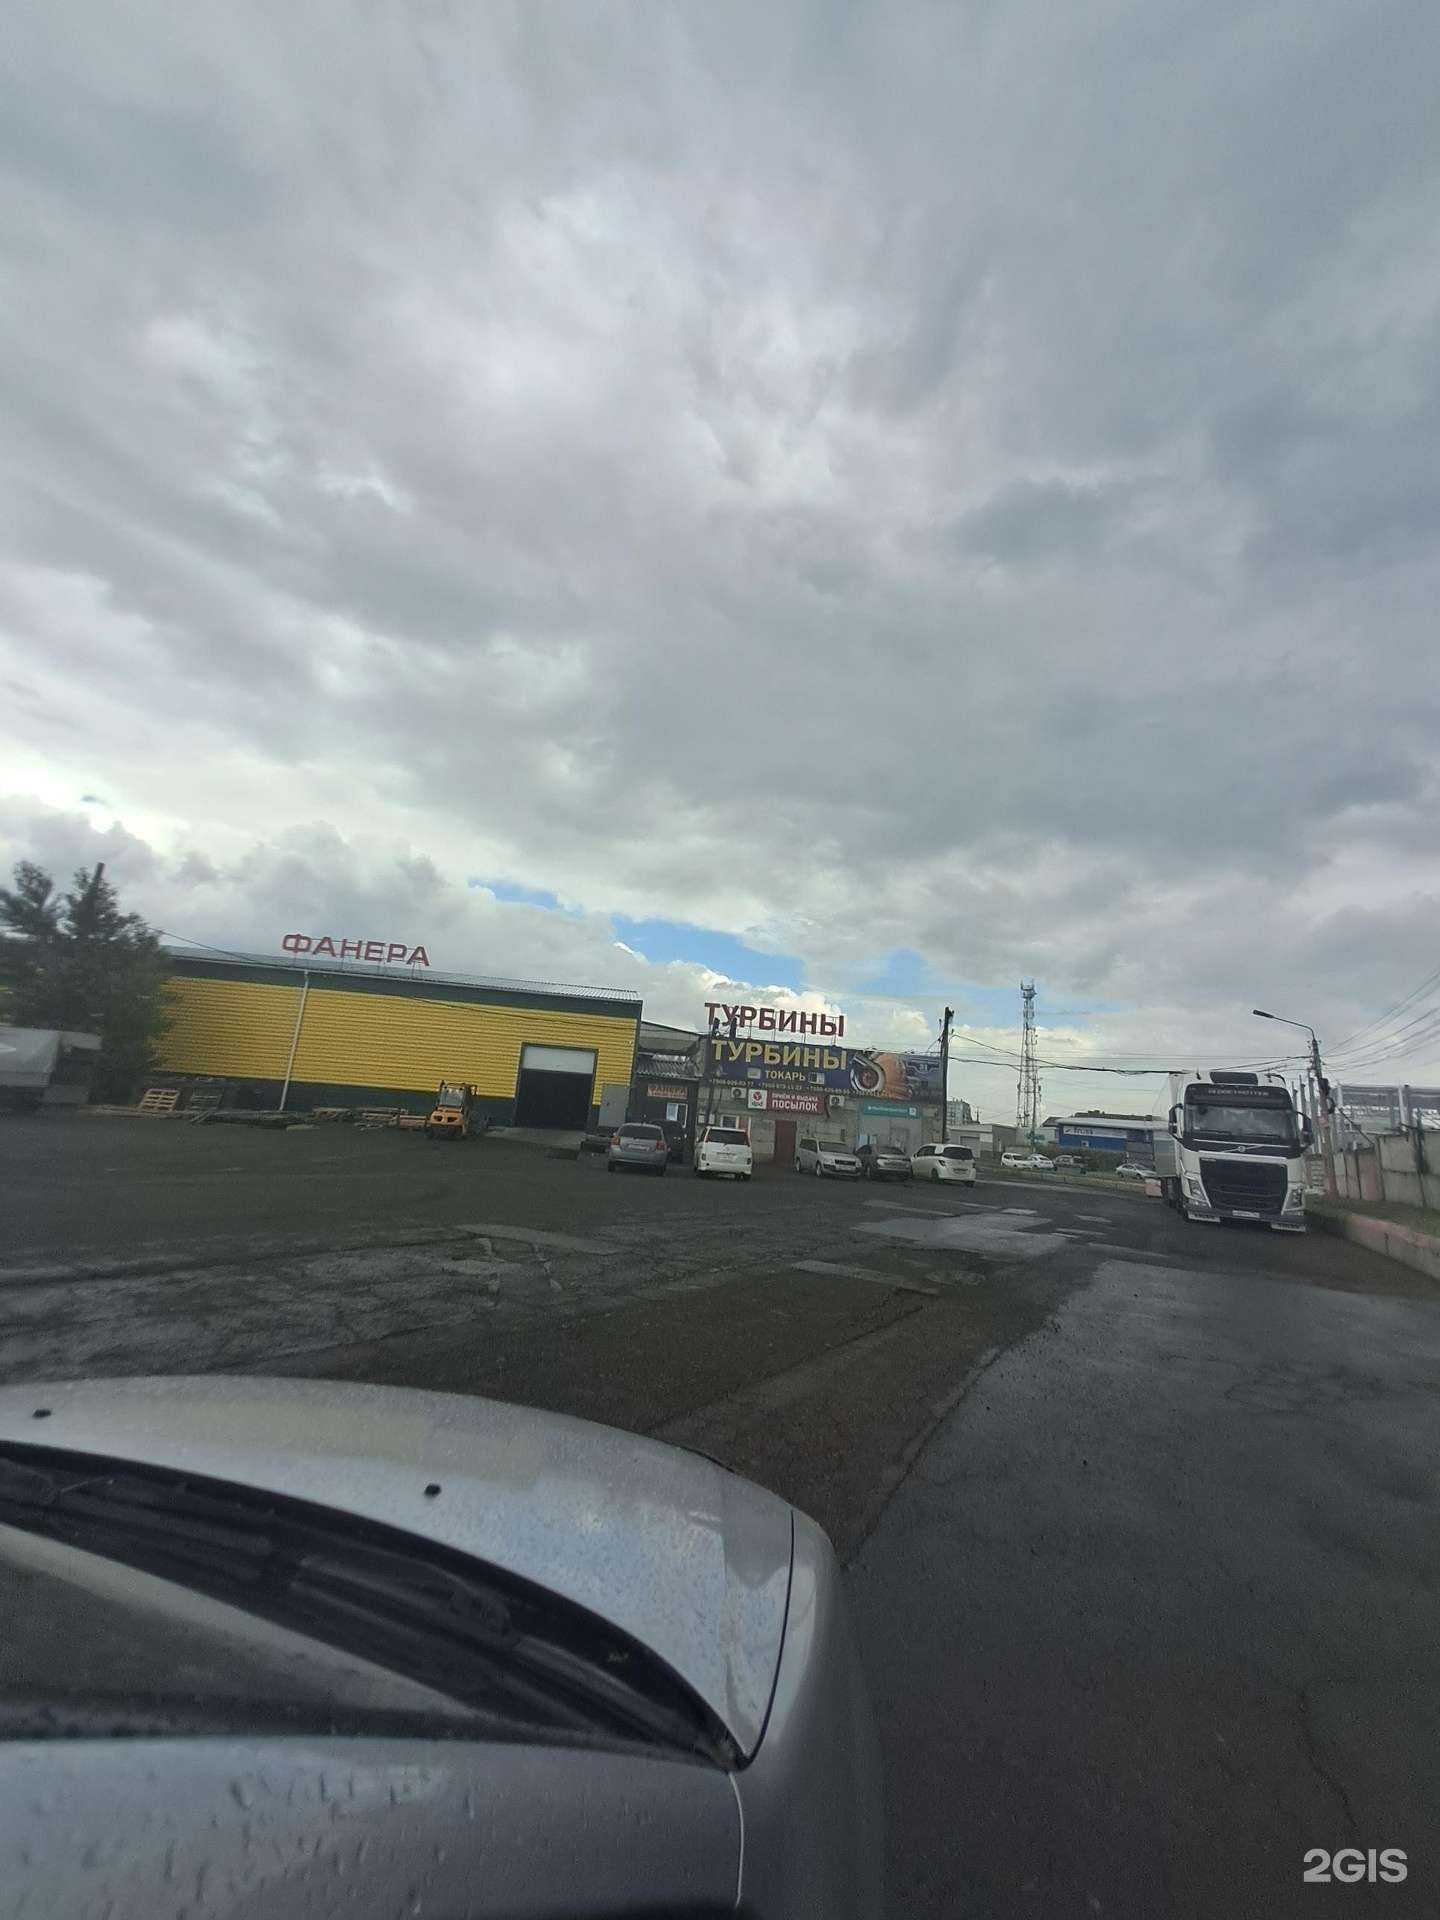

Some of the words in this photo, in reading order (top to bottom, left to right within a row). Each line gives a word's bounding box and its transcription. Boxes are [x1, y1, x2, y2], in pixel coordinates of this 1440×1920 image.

[282, 933, 430, 966] ФАНЕРА
[704, 1002, 845, 1037] ТУРБИНЫ
[711, 1039, 847, 1070] ТУРБИНЫ
[765, 1070, 806, 1081] ТОКАРЬ
[772, 1100, 818, 1112] ПОСЫЛОК
